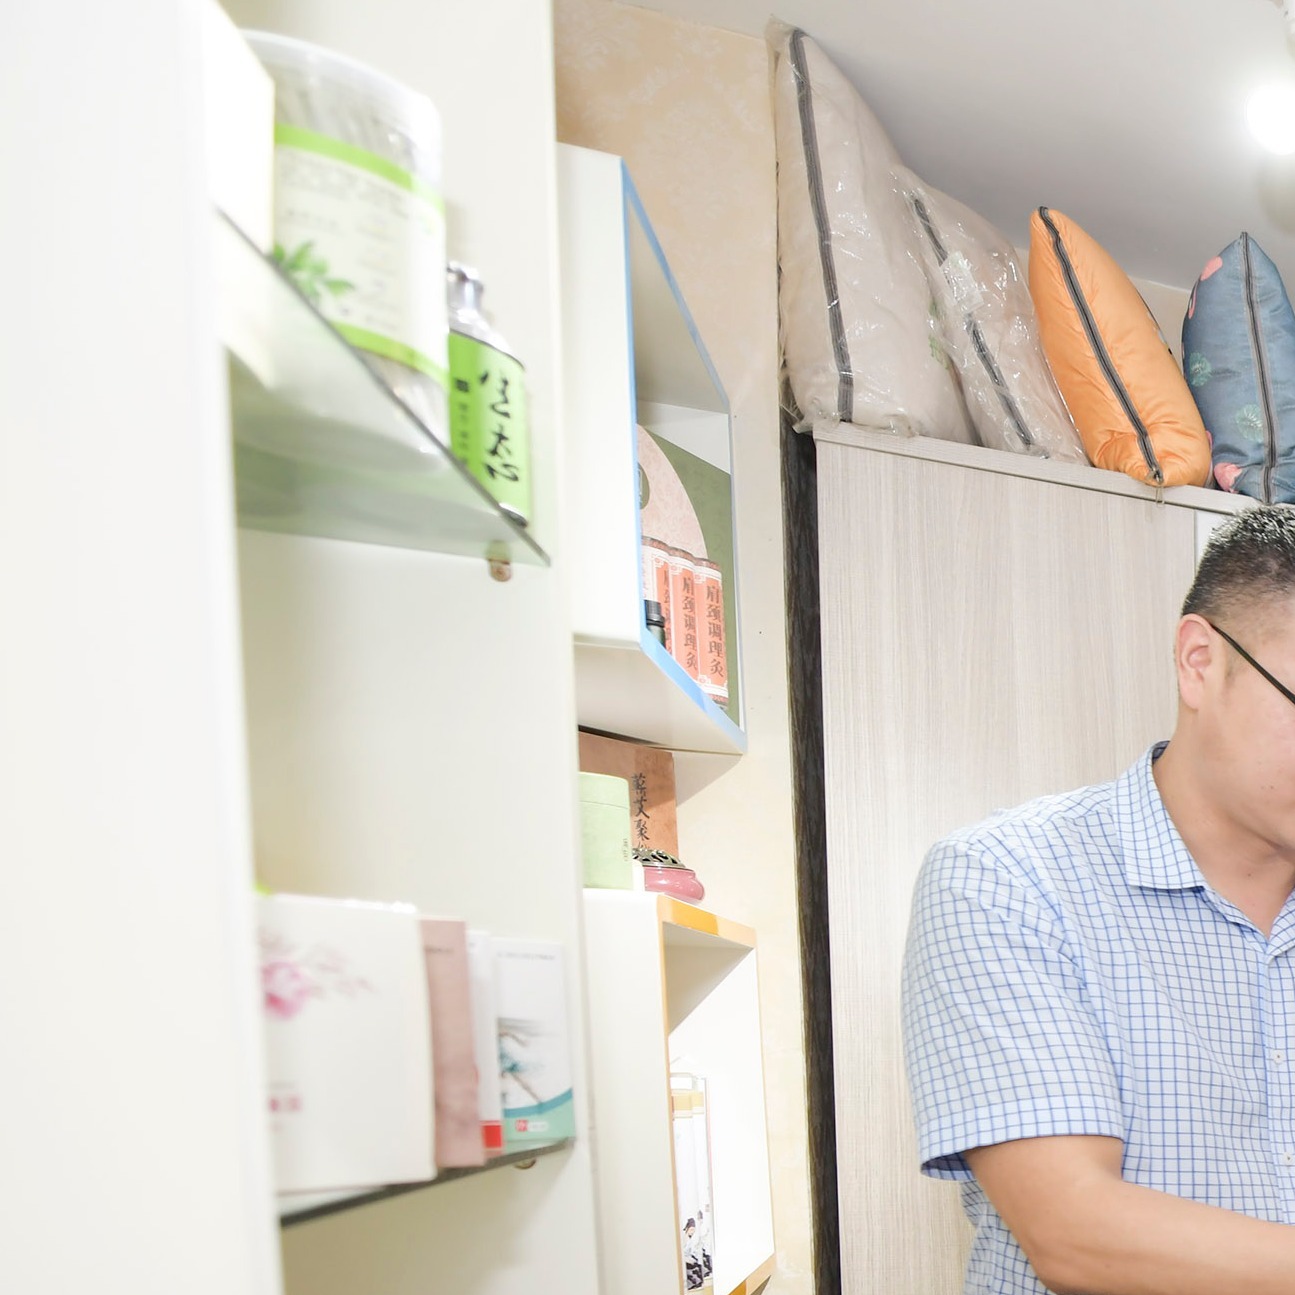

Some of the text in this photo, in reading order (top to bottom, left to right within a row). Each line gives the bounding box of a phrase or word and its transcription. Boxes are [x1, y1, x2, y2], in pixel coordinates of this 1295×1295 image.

[706, 583, 724, 678] 肩颈调理灸
